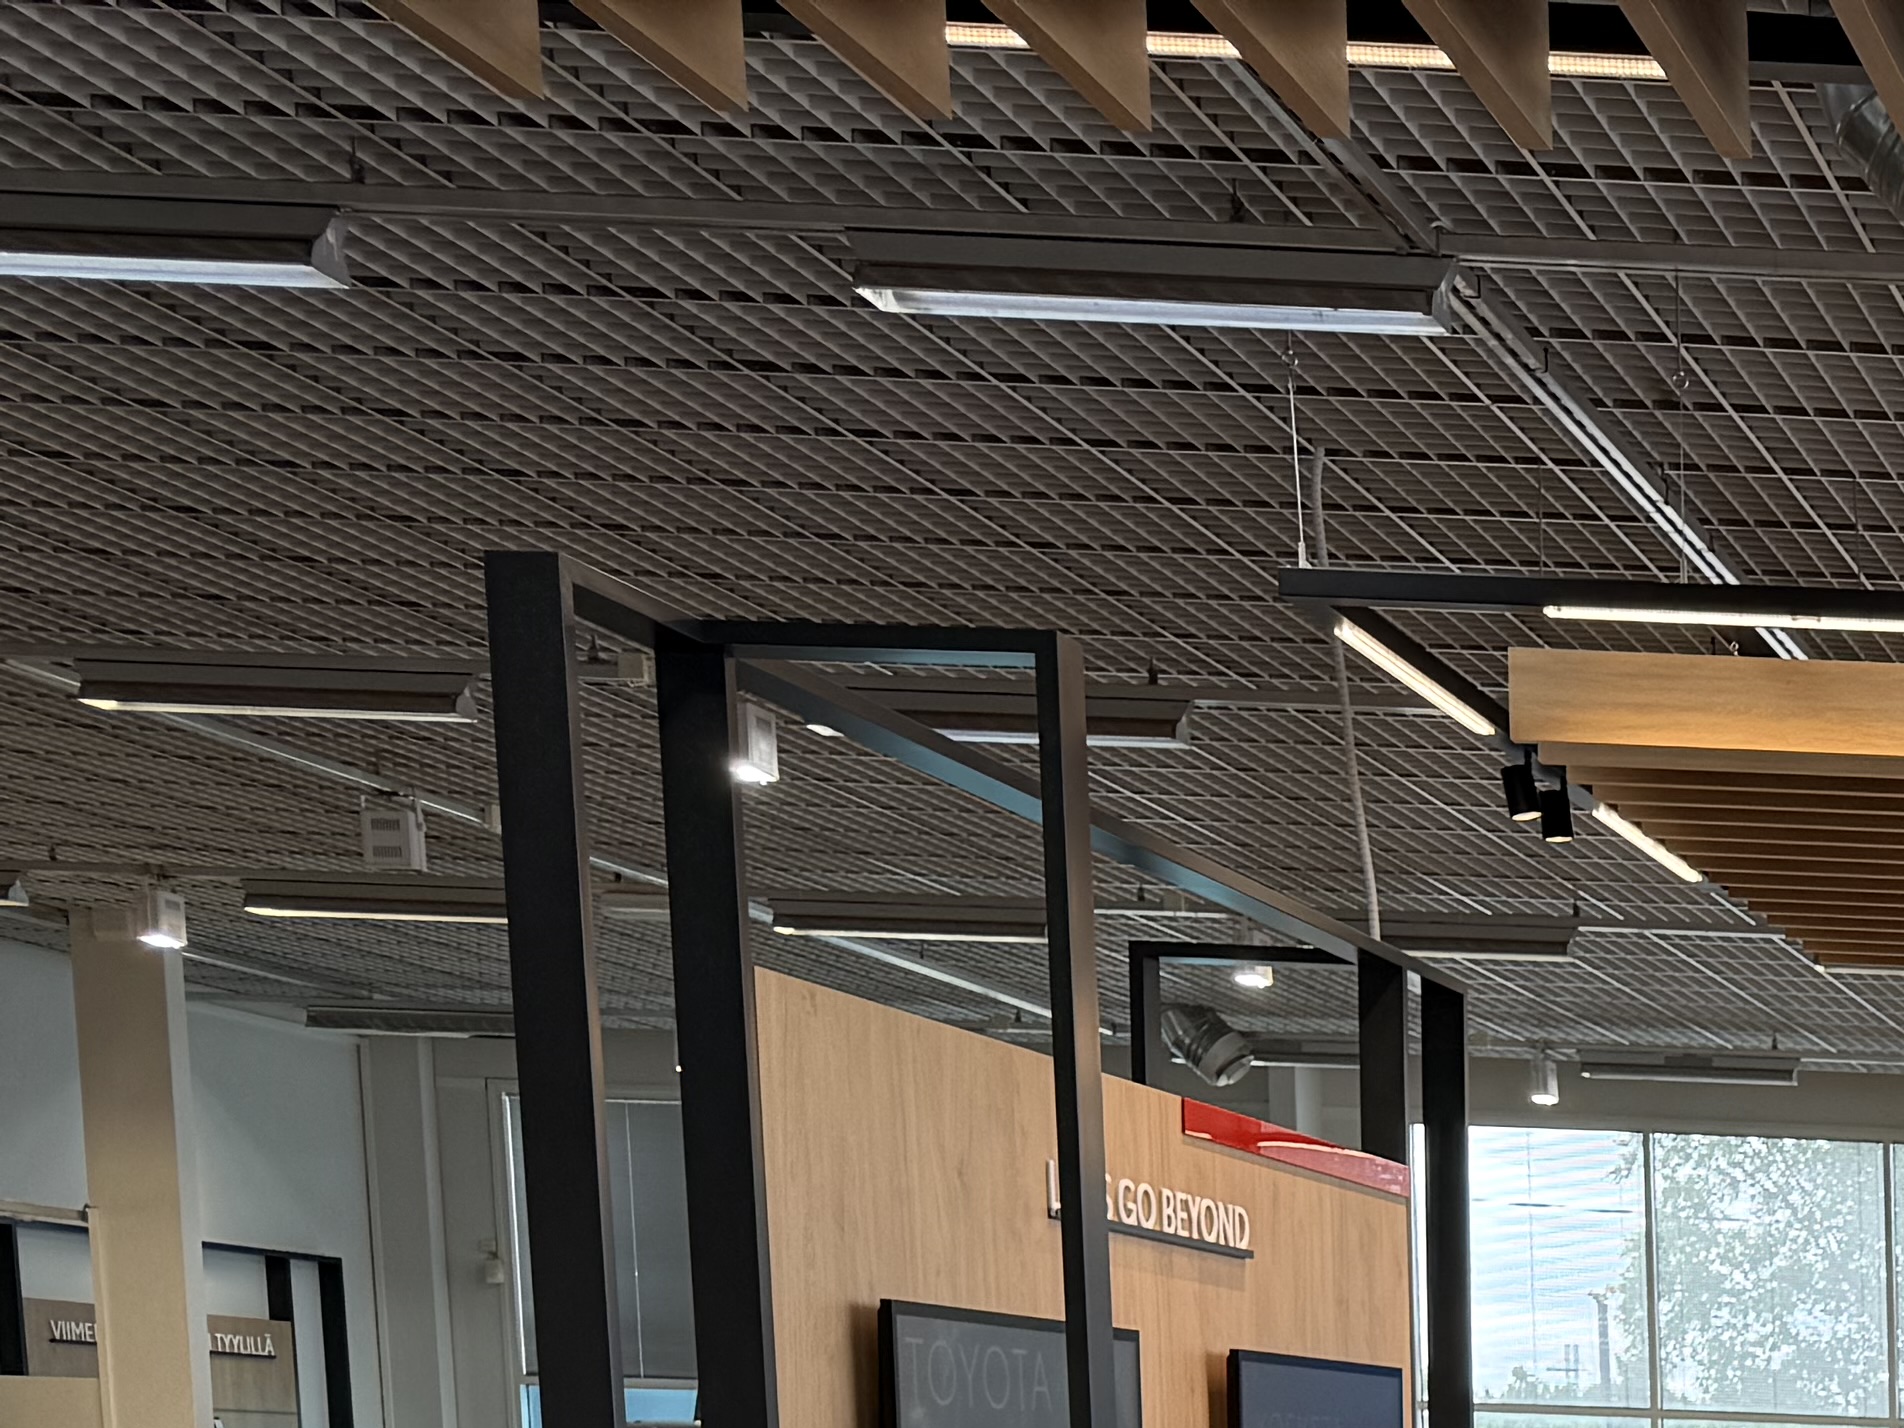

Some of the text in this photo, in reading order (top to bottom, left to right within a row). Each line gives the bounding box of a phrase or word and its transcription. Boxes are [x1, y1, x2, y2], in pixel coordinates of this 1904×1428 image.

[1118, 1178, 1157, 1229] GO
[1160, 1187, 1251, 1250] BEYOND
[903, 1337, 1053, 1413] TOYOTA
